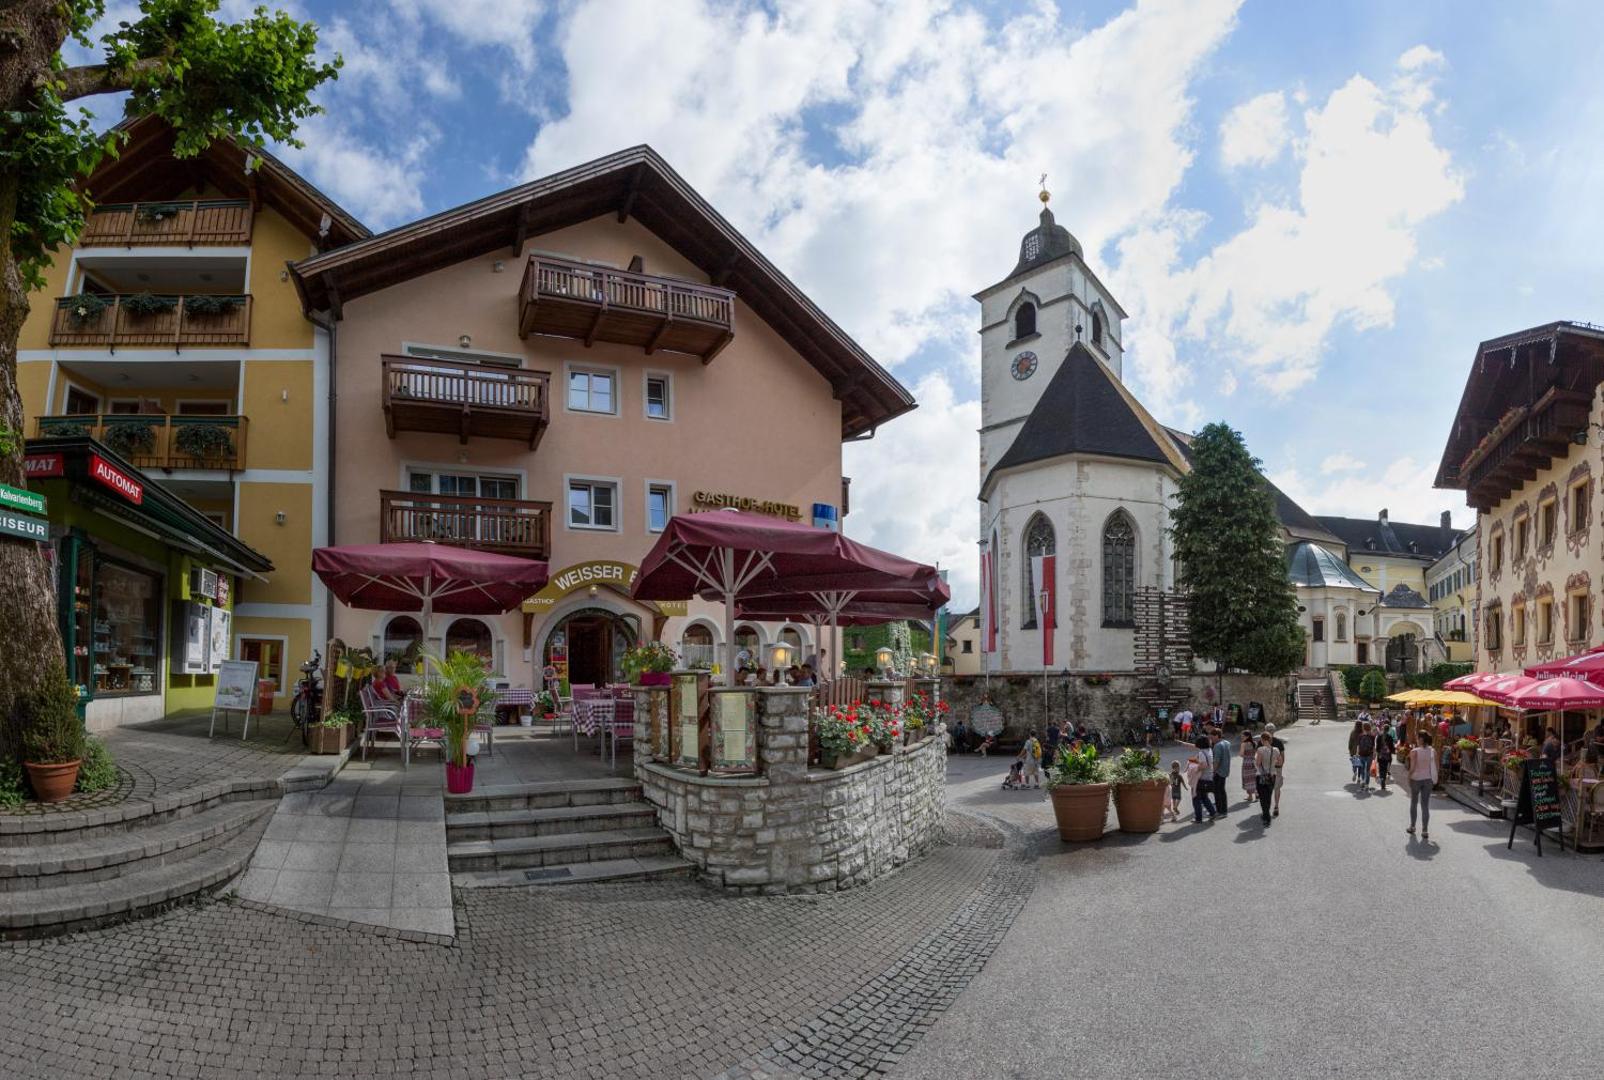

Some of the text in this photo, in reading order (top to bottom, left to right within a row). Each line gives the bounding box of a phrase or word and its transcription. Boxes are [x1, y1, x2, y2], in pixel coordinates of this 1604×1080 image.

[97, 463, 140, 498] AUTOMAT
[0, 489, 43, 511] Kalvarienberg
[694, 490, 802, 519] GASTHOF HOTEL
[0, 516, 45, 536] ISEUR
[555, 565, 622, 590] WEISSER
